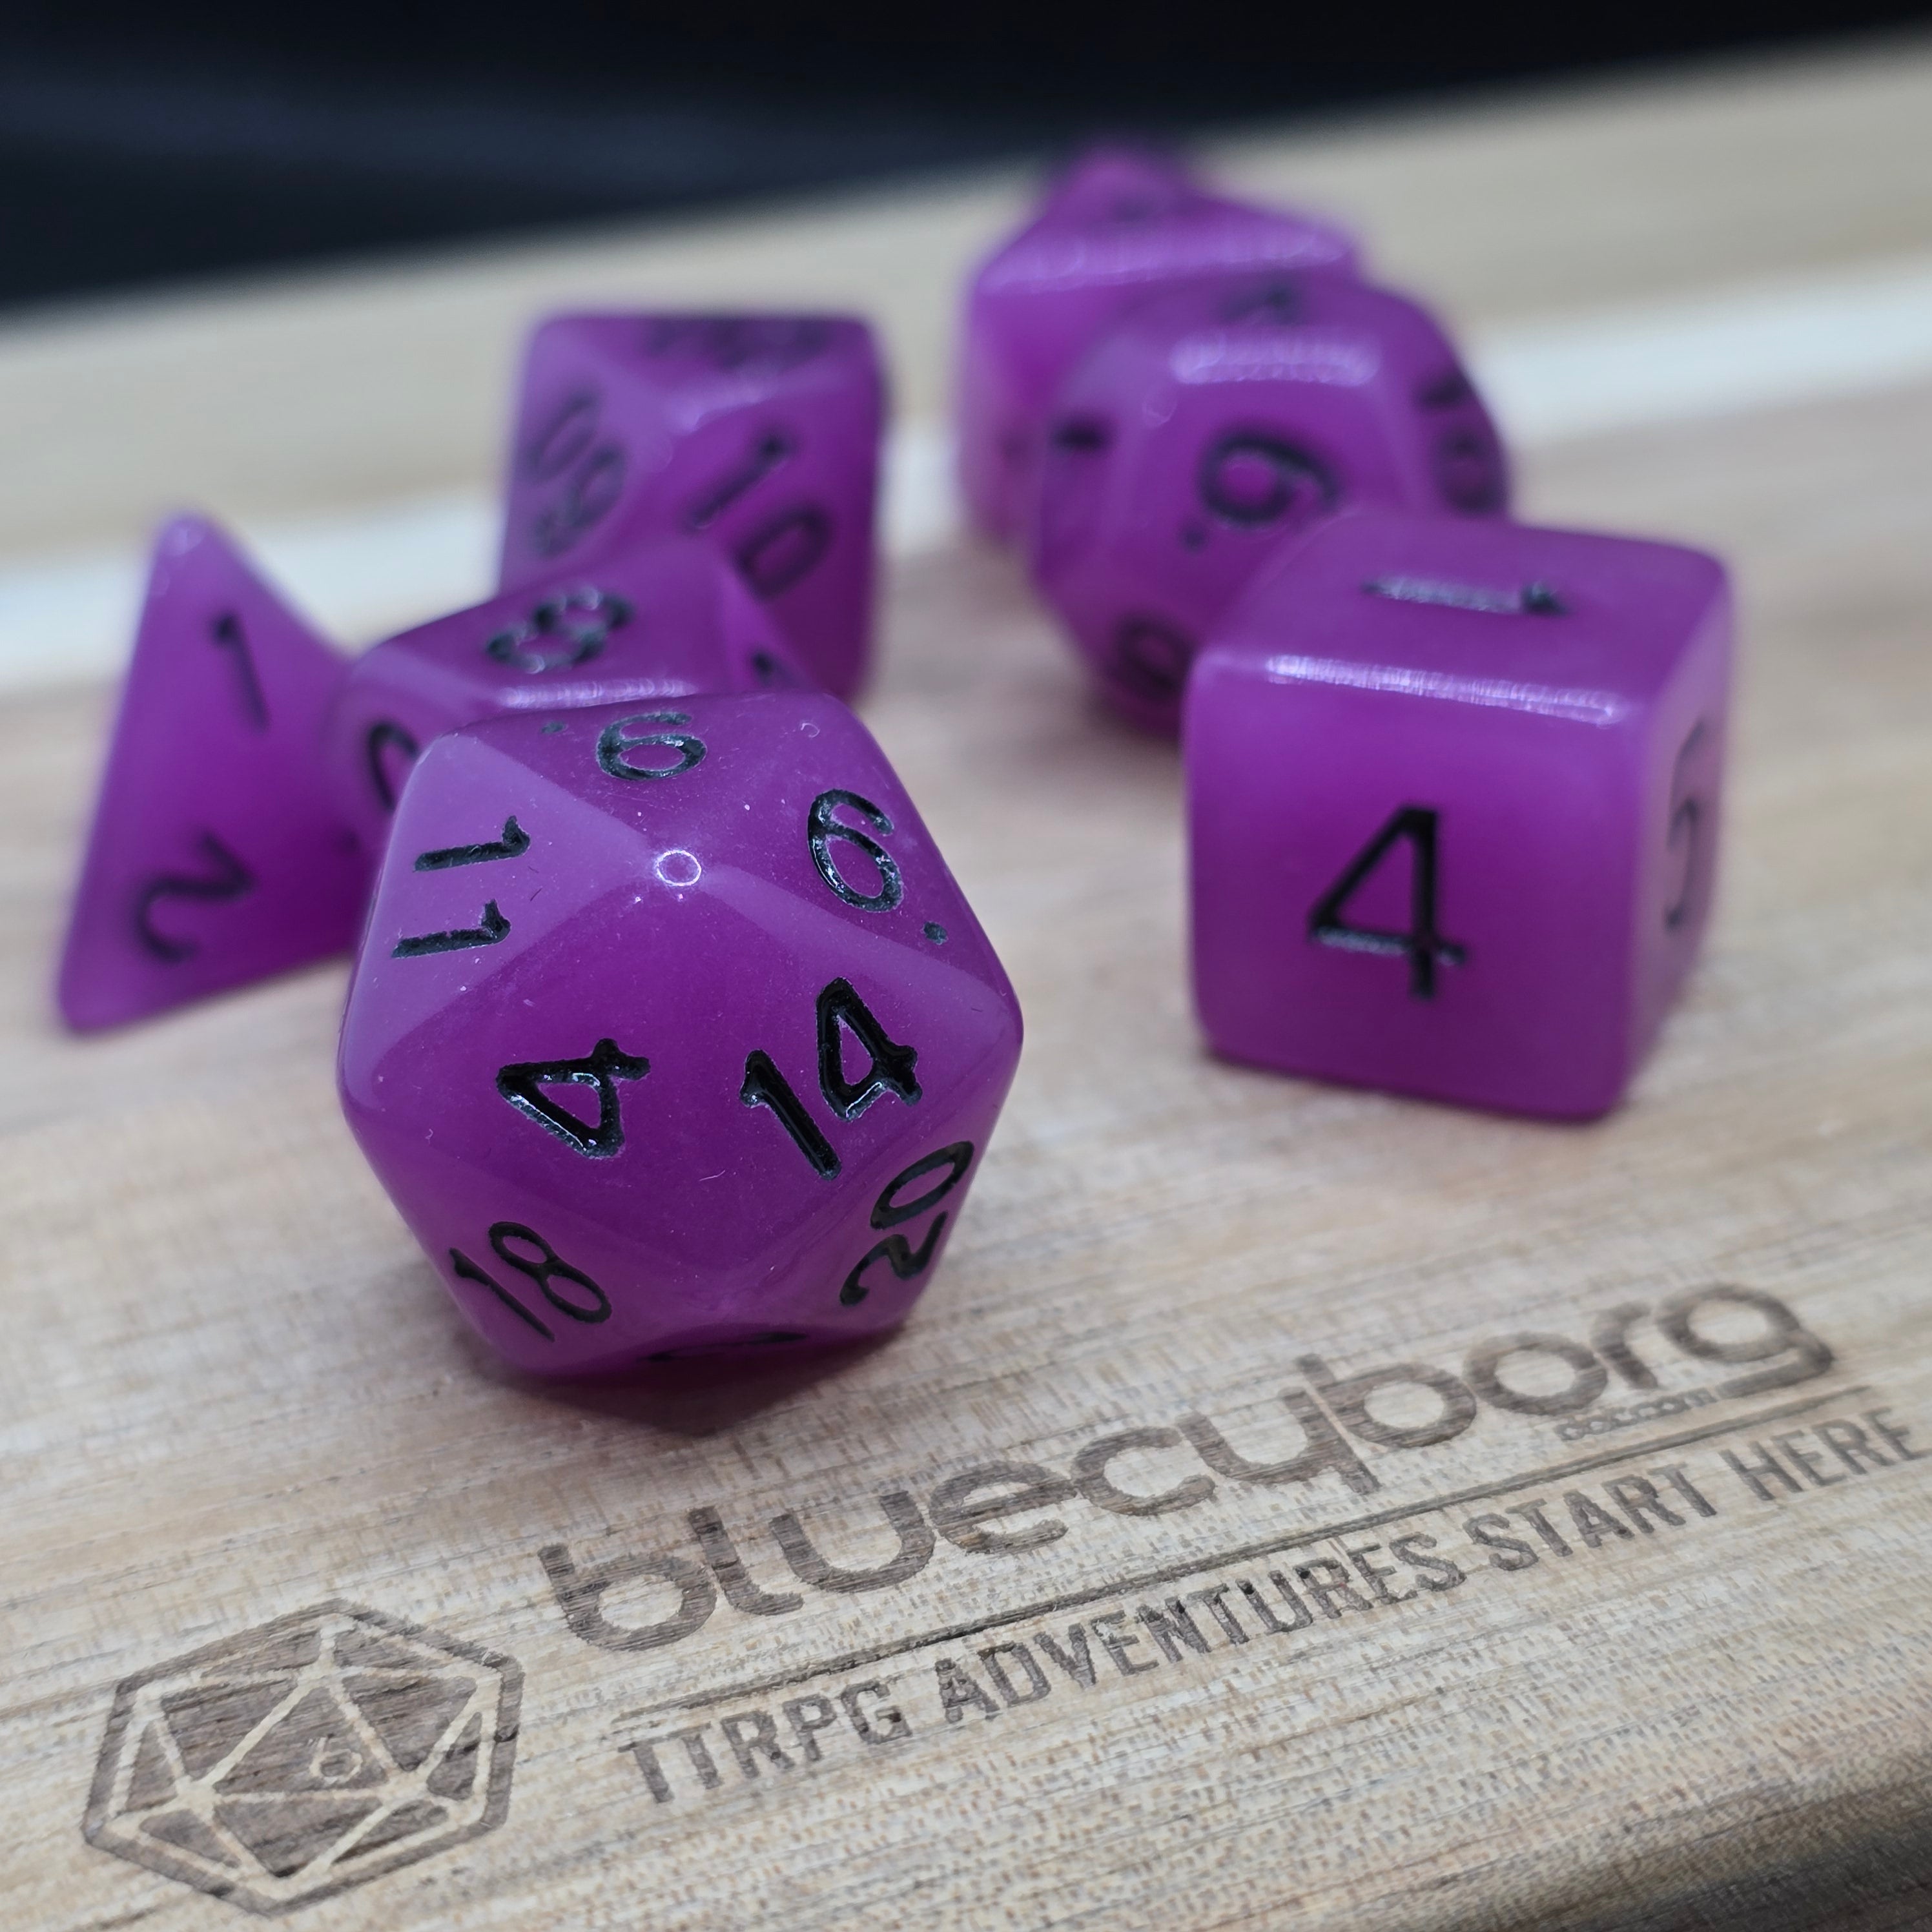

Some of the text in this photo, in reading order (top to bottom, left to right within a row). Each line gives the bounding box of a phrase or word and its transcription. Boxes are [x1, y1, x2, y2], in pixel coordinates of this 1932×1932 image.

[688, 429, 833, 599] 10
[210, 610, 271, 733] 1
[1361, 577, 1570, 617] 1
[134, 832, 253, 962] 2
[391, 815, 531, 958] 11
[1308, 804, 1467, 1000] 4
[496, 1037, 651, 1160] 4
[739, 976, 923, 1180] 14
[449, 1220, 612, 1343] 18
[839, 1140, 975, 1307] 20
[538, 1282, 1836, 1652] bluecyborg
[617, 1406, 1932, 1804] TTRPG ADVENTURES START HERE
